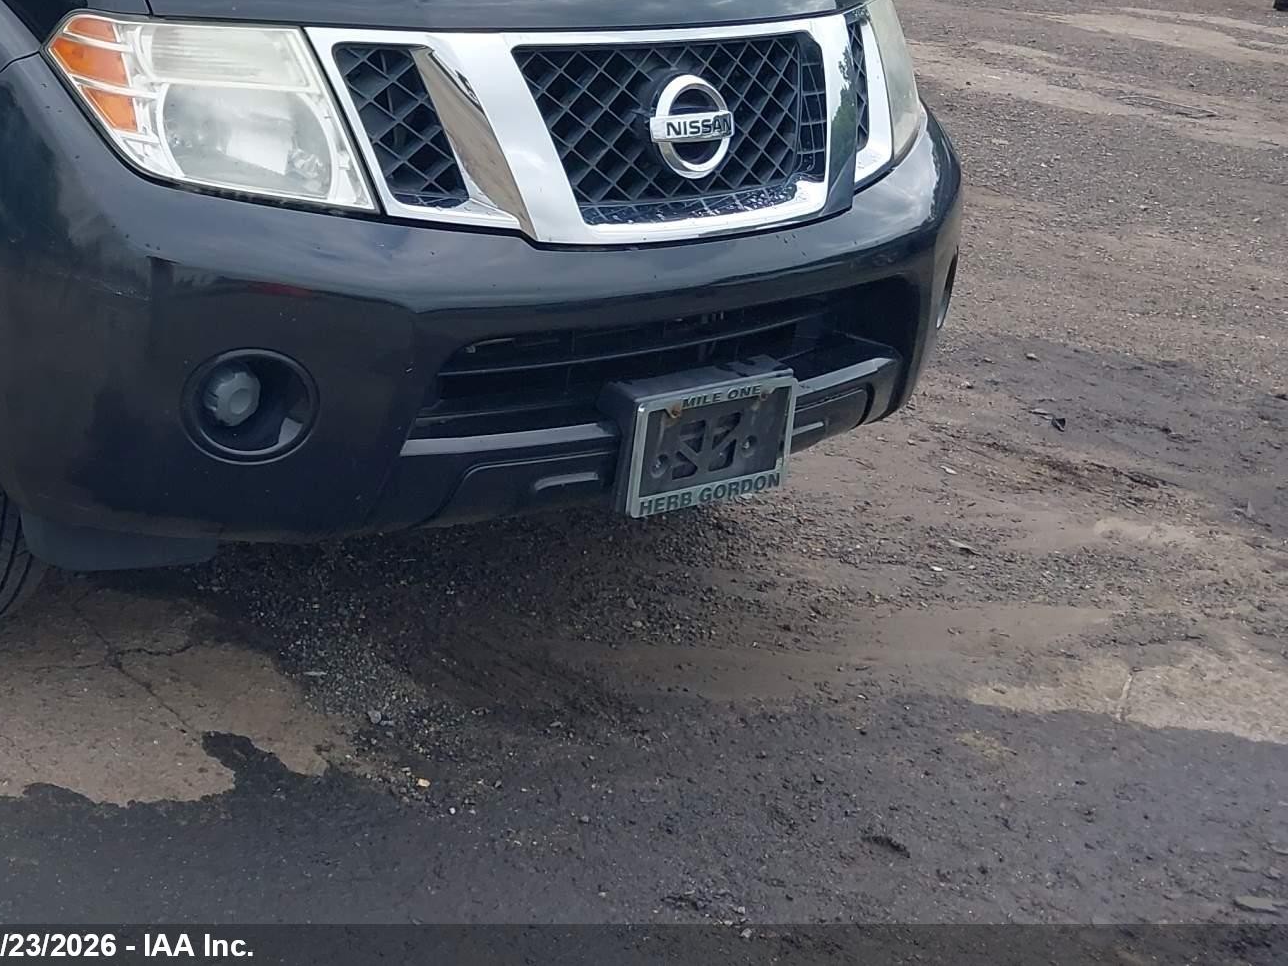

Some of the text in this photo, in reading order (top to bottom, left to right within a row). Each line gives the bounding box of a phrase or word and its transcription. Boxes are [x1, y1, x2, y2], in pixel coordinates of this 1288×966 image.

[666, 115, 732, 137] NISSAN
[681, 384, 762, 409] MILE ONE
[639, 472, 781, 516] HERB GORDON
